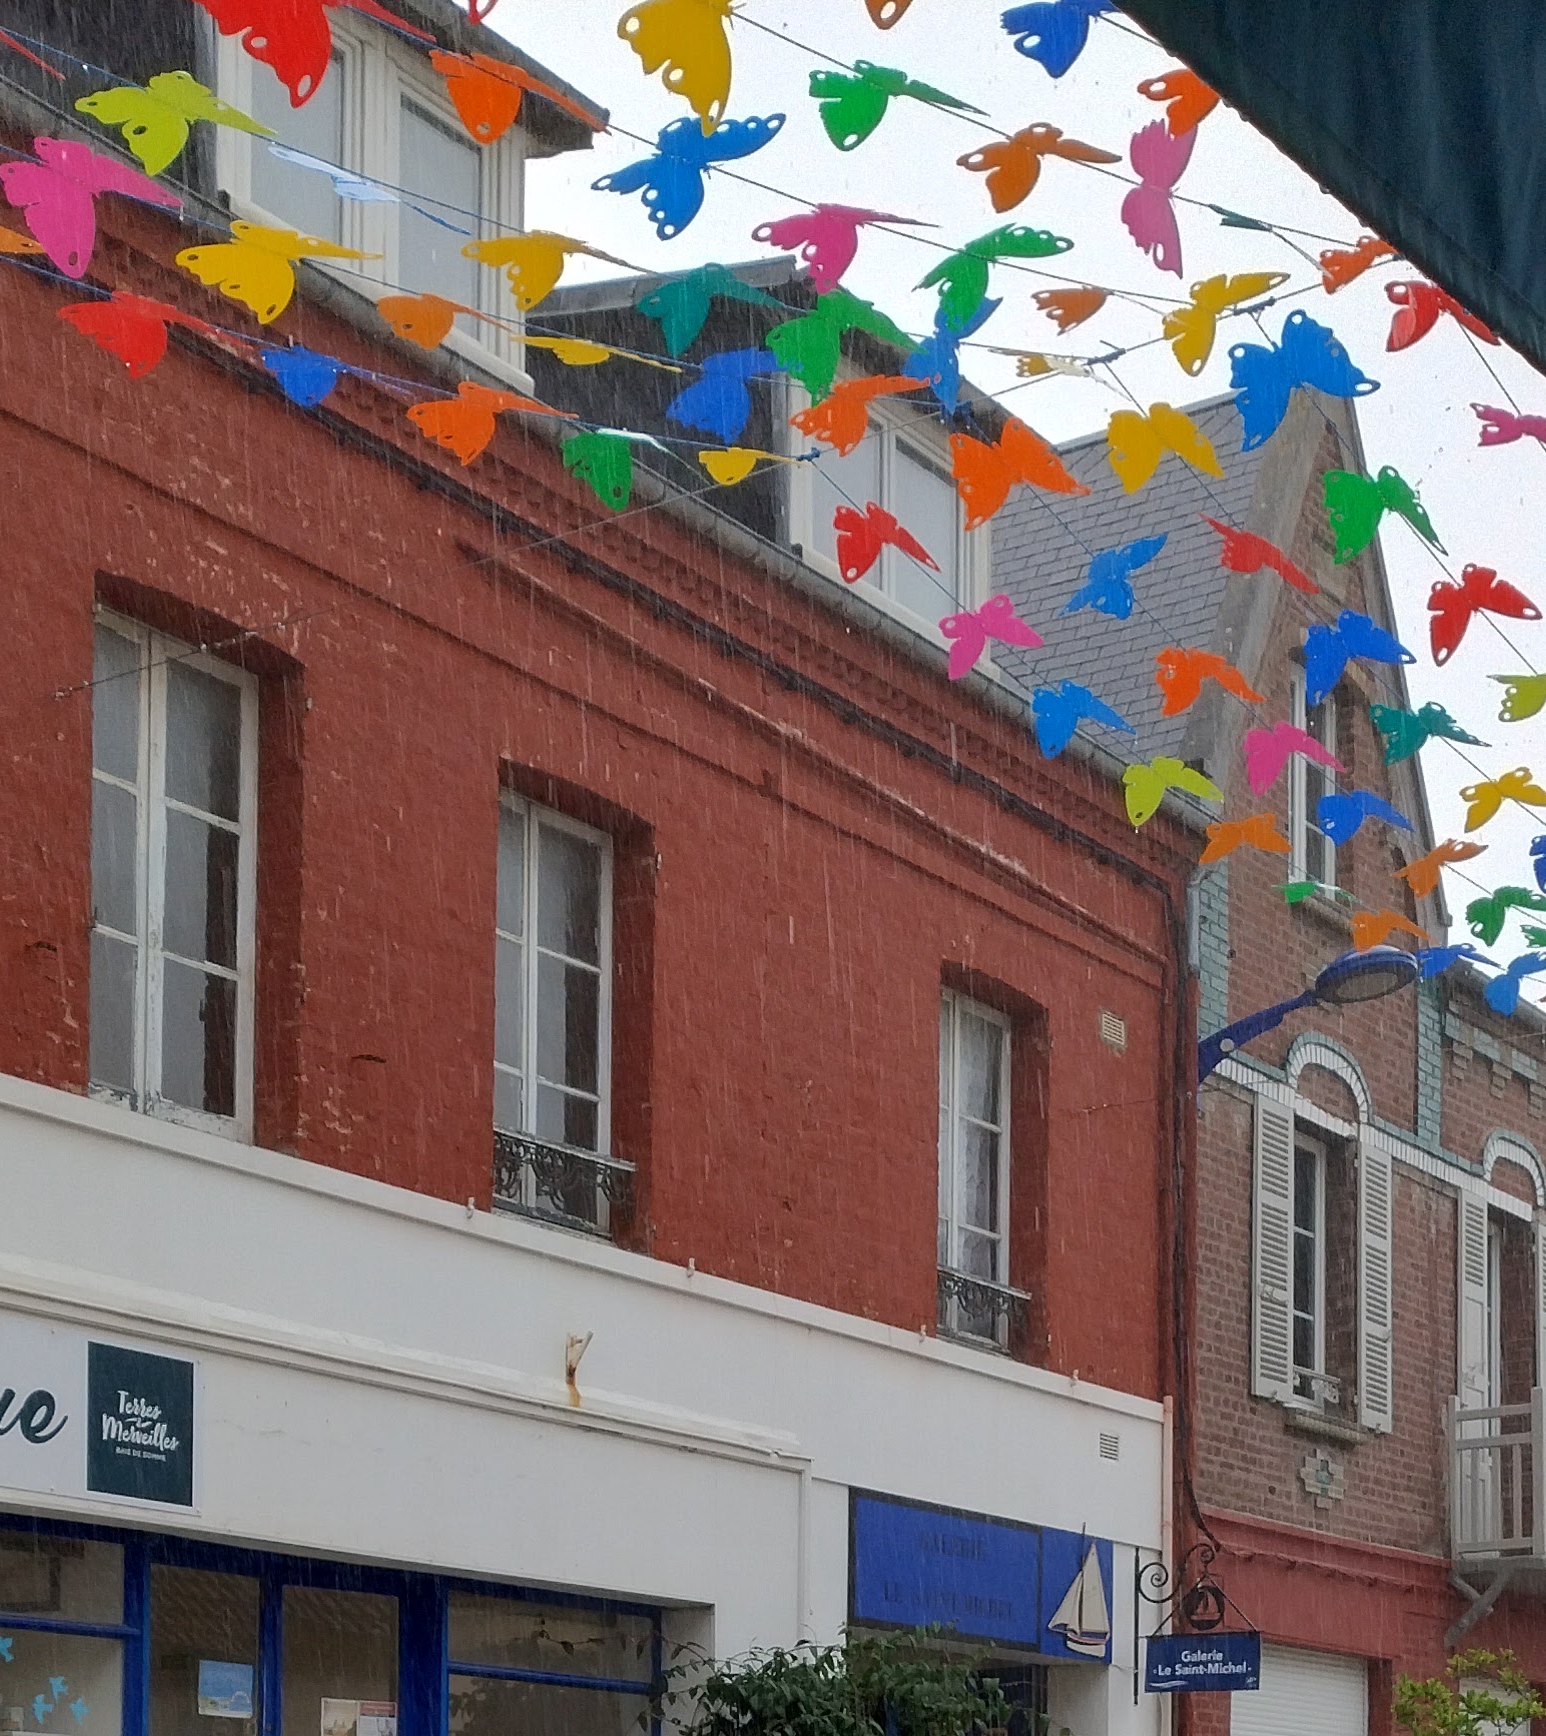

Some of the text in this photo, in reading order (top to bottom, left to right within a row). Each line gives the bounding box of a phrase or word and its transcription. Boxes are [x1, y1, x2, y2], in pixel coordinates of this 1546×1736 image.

[117, 1390, 162, 1420] Terres
[102, 1413, 180, 1451] Merveilles
[1181, 1649, 1224, 1662] Galerie
[1175, 1661, 1247, 1676] Saint-Michel
